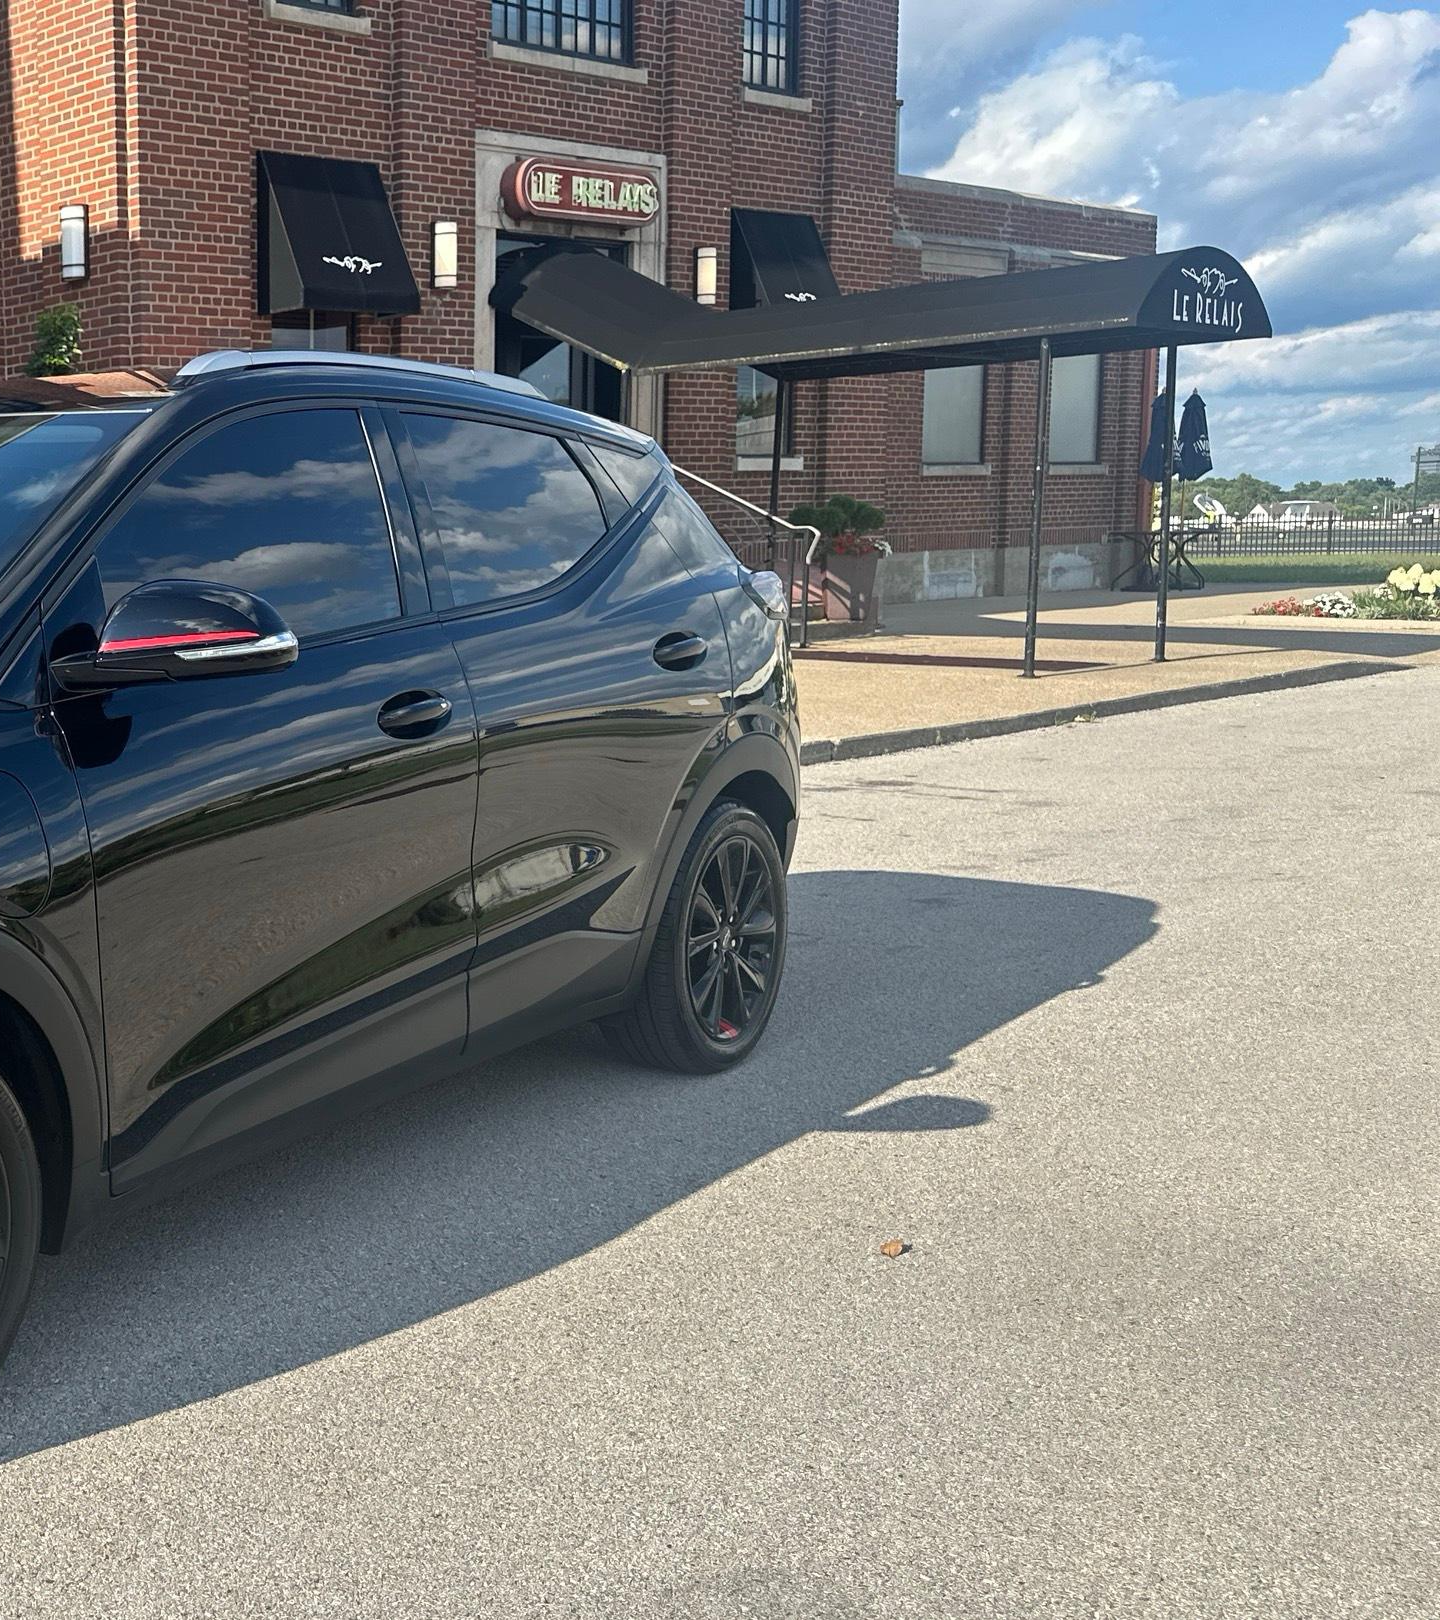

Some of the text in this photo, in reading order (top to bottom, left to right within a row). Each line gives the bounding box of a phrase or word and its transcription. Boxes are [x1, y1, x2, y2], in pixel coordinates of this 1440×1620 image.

[530, 170, 563, 204] LE
[1173, 289, 1243, 333] LE RELAIS
